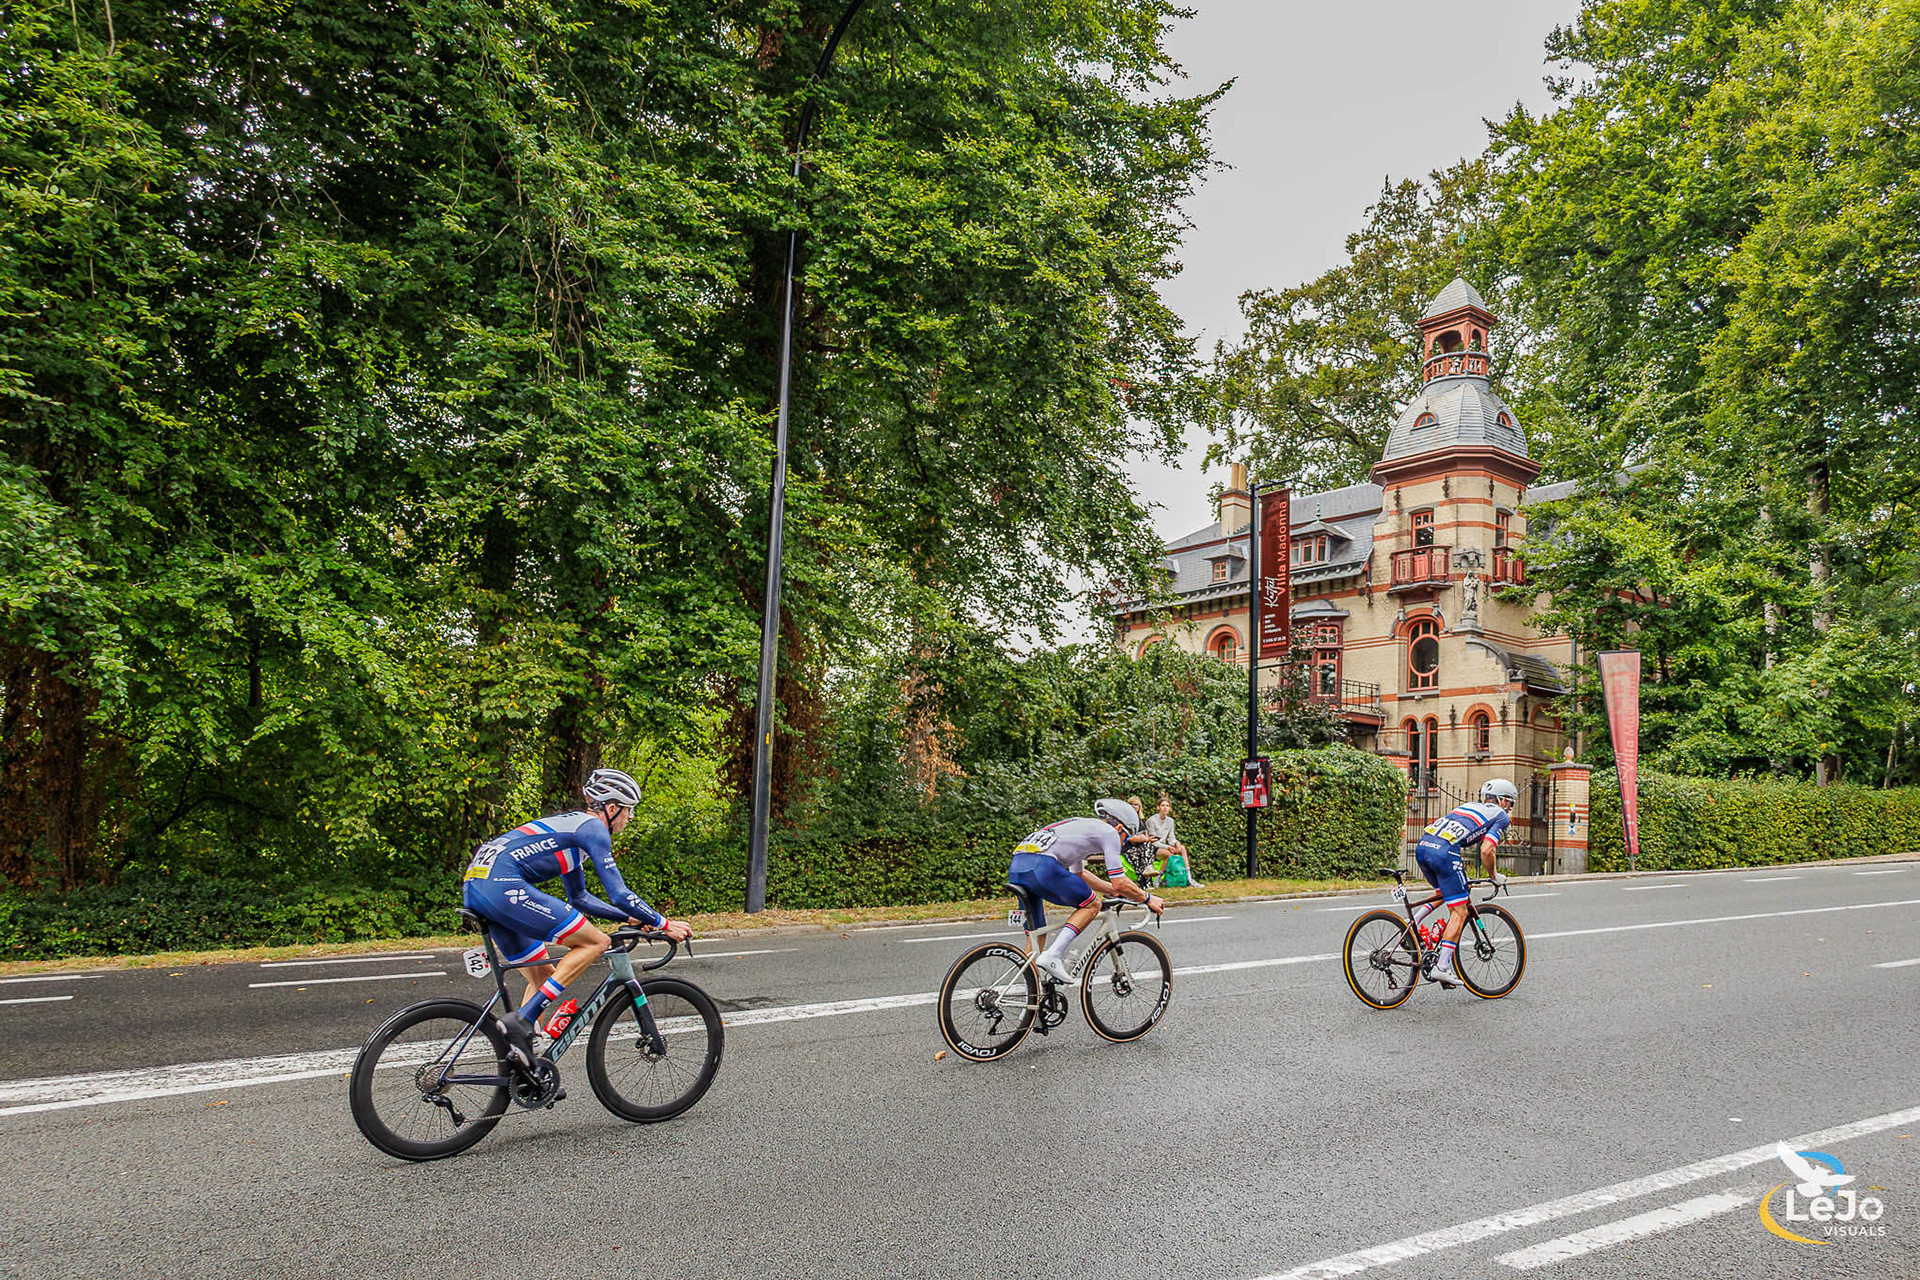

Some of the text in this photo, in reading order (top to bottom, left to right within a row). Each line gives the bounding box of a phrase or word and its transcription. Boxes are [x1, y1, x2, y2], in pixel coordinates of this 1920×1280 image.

[1276, 501, 1287, 597] Villa Madonna
[1466, 827, 1487, 844] FRANCE
[509, 837, 559, 862] FRANCE
[1009, 914, 1022, 925] 144
[467, 952, 484, 974] 142
[986, 947, 1025, 965] roval
[1150, 981, 1171, 1024] roval
[551, 986, 608, 1063] GIANT
[957, 1041, 997, 1057] roval
